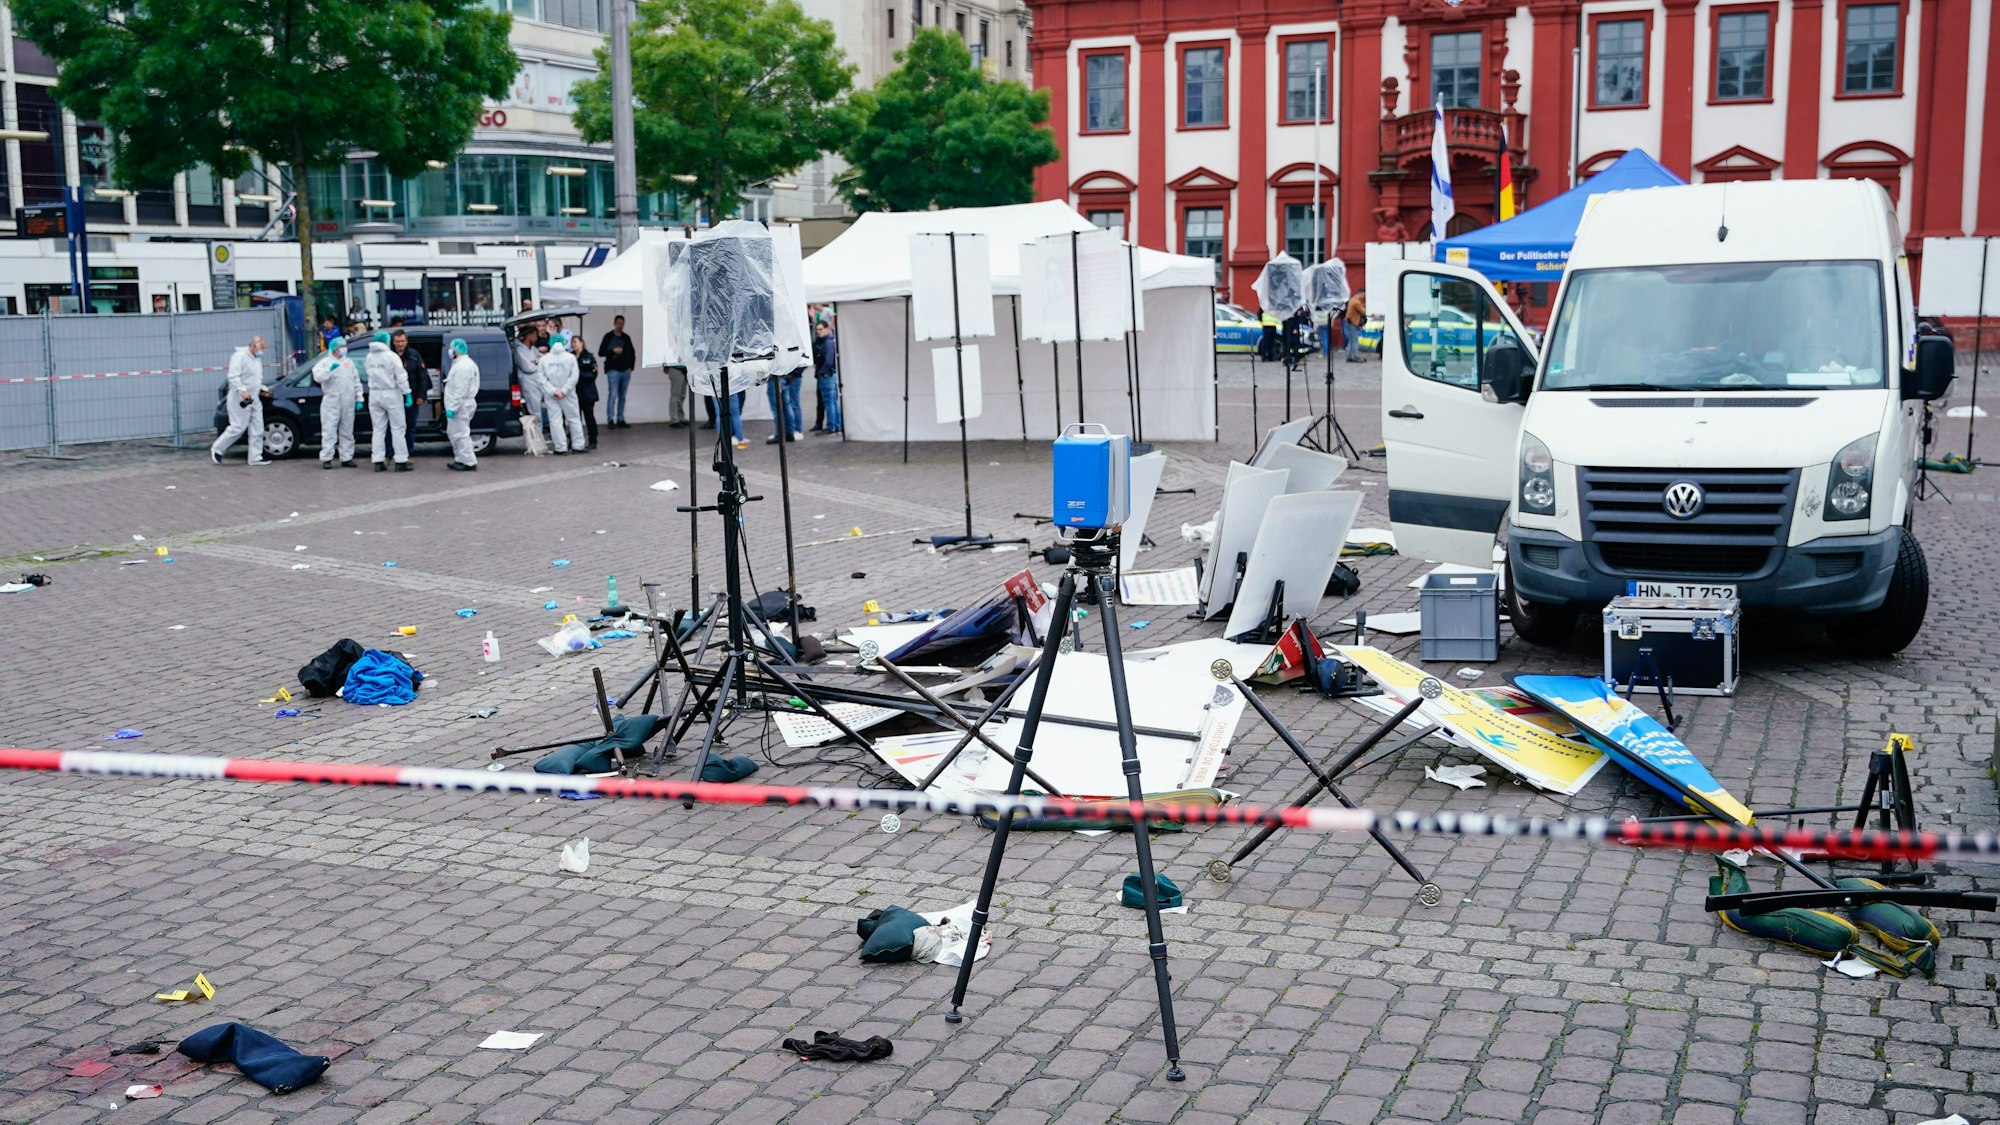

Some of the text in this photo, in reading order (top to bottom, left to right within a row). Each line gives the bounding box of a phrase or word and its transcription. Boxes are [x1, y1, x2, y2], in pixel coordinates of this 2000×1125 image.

[476, 110, 507, 127] GO
[1500, 250, 1573, 260] Der Politische Isl
[1639, 585, 1660, 597] HN
[1700, 587, 1733, 599] 752
[1526, 729, 1596, 755] Normen
